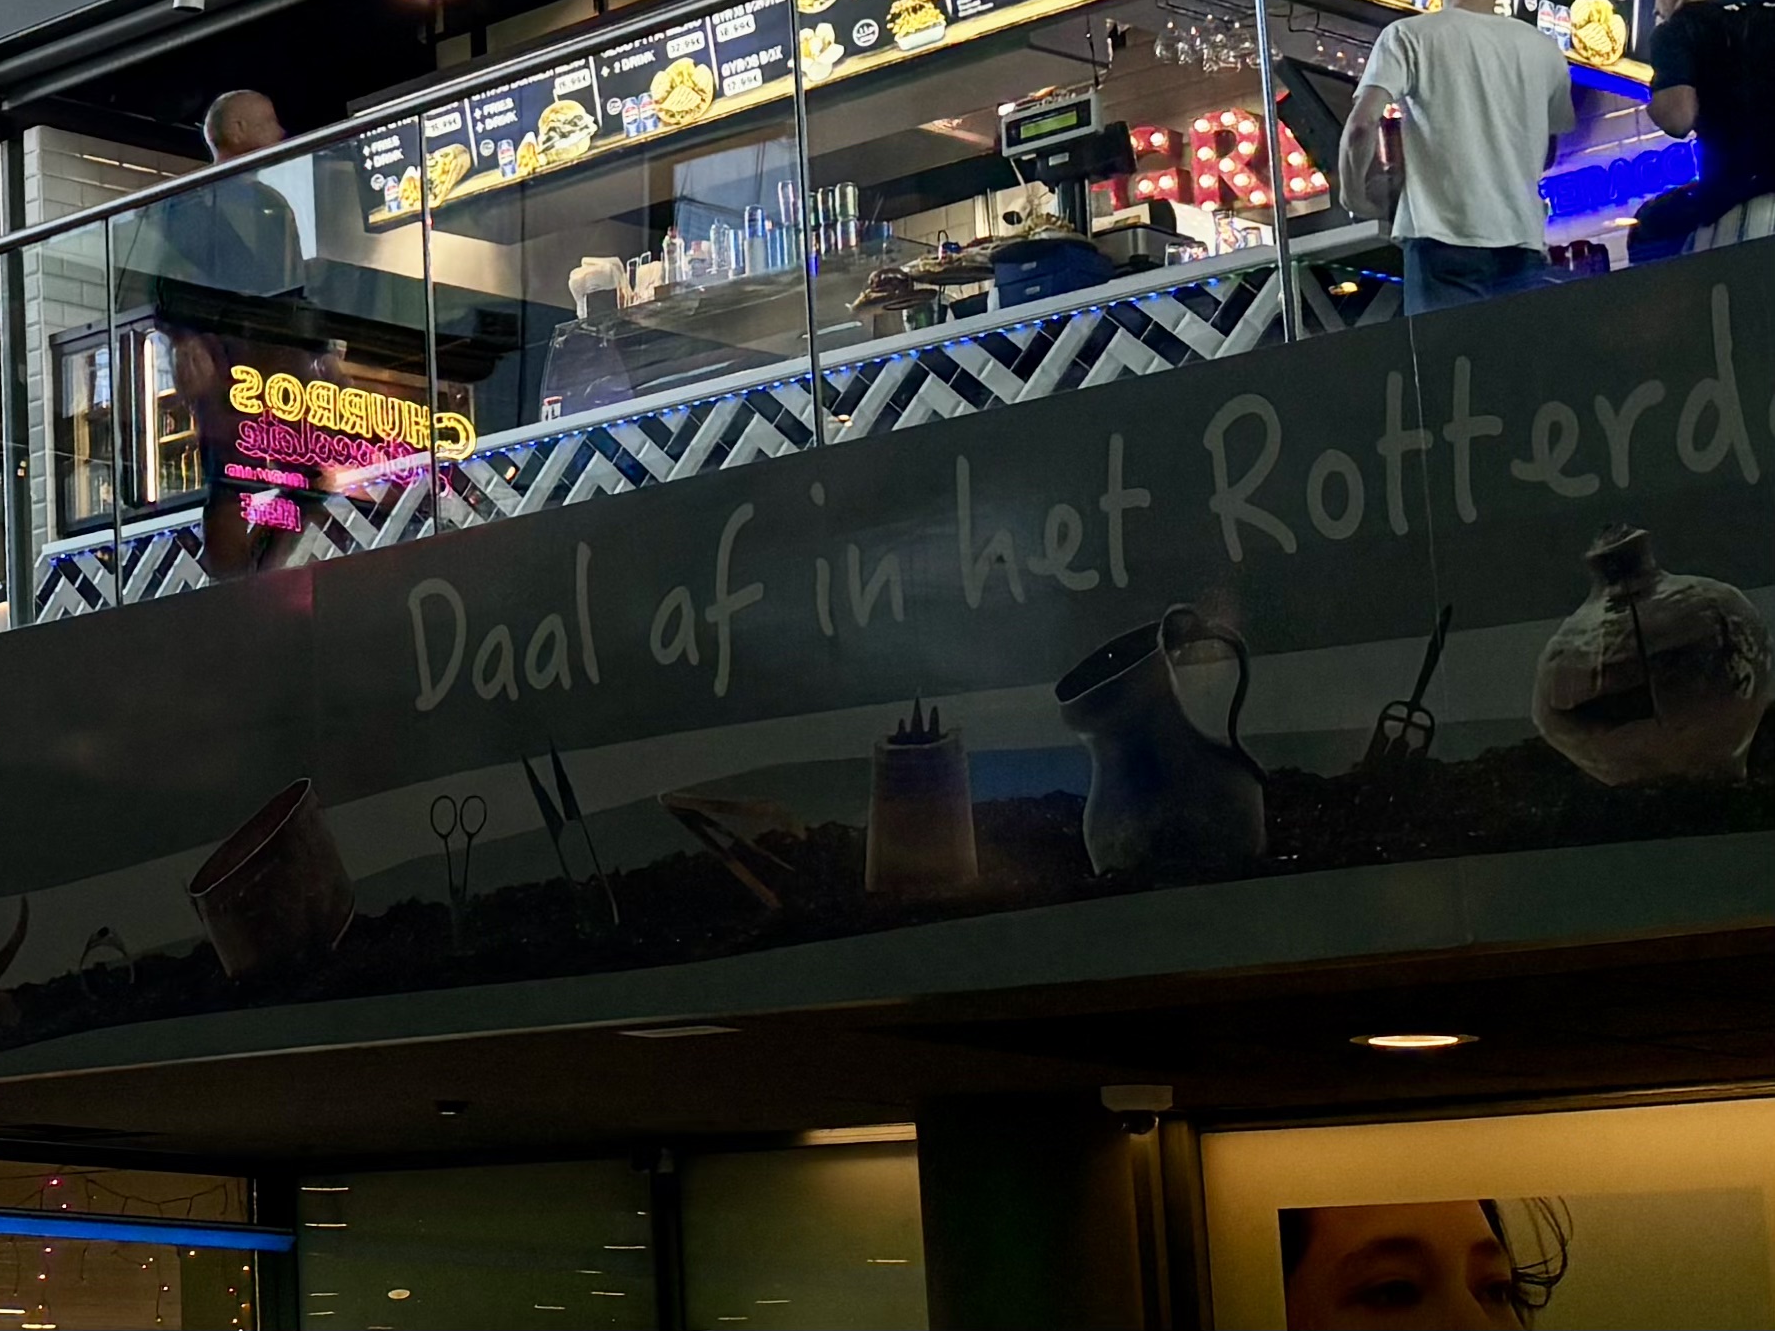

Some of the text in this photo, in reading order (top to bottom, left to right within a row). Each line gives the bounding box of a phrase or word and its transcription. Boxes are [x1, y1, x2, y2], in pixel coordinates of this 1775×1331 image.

[721, 45, 784, 77] GYROS BOX
[408, 283, 1775, 712] Daal af in het Rotterd
